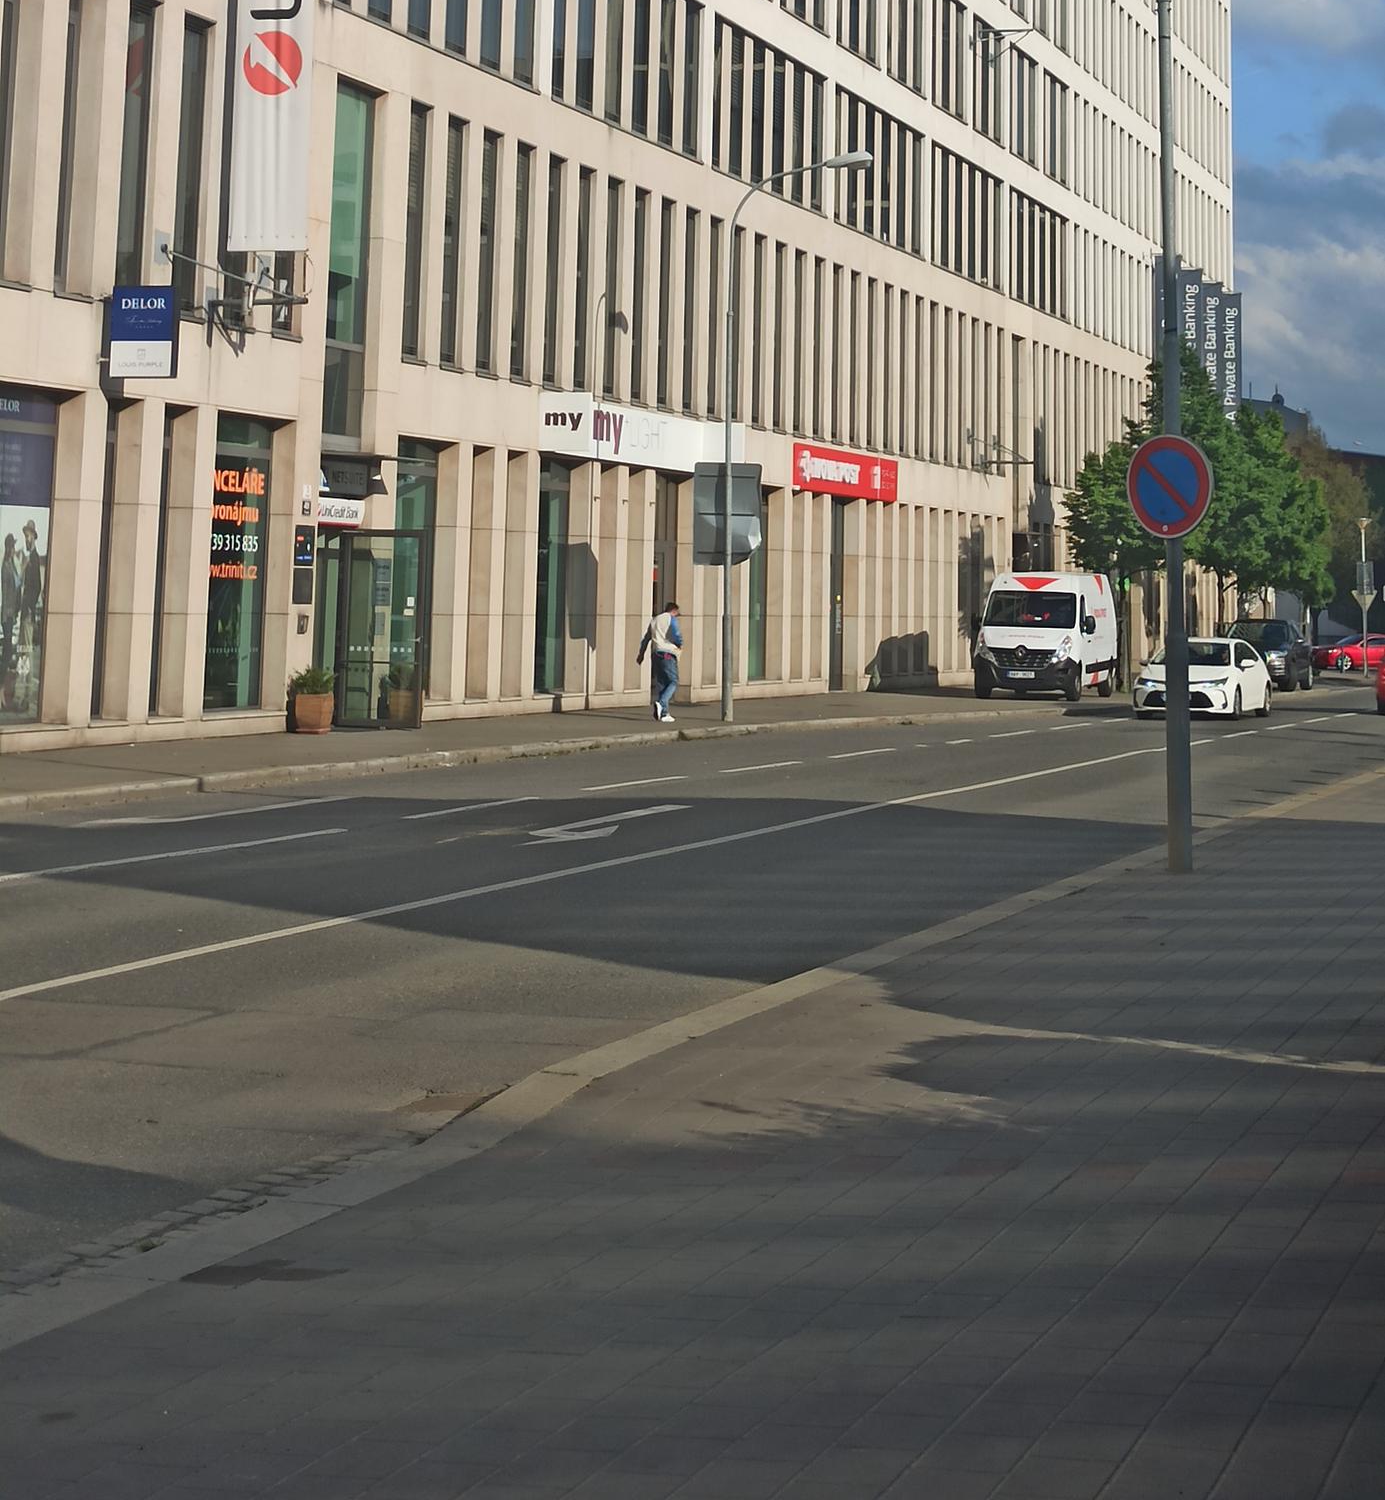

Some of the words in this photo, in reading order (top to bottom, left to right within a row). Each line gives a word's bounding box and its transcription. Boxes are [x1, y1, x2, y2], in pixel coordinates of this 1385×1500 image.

[121, 298, 166, 310] DELOR
[1203, 296, 1220, 350] Banking
[1222, 307, 1239, 359] Banking
[1223, 361, 1236, 406] Private
[0, 398, 20, 413] ELOR
[544, 411, 583, 431] my
[213, 467, 265, 495] NCELÁŘE
[321, 504, 346, 518] UniCredit
[346, 506, 359, 519] Bank
[224, 534, 240, 551] 315
[242, 535, 259, 552] 835
